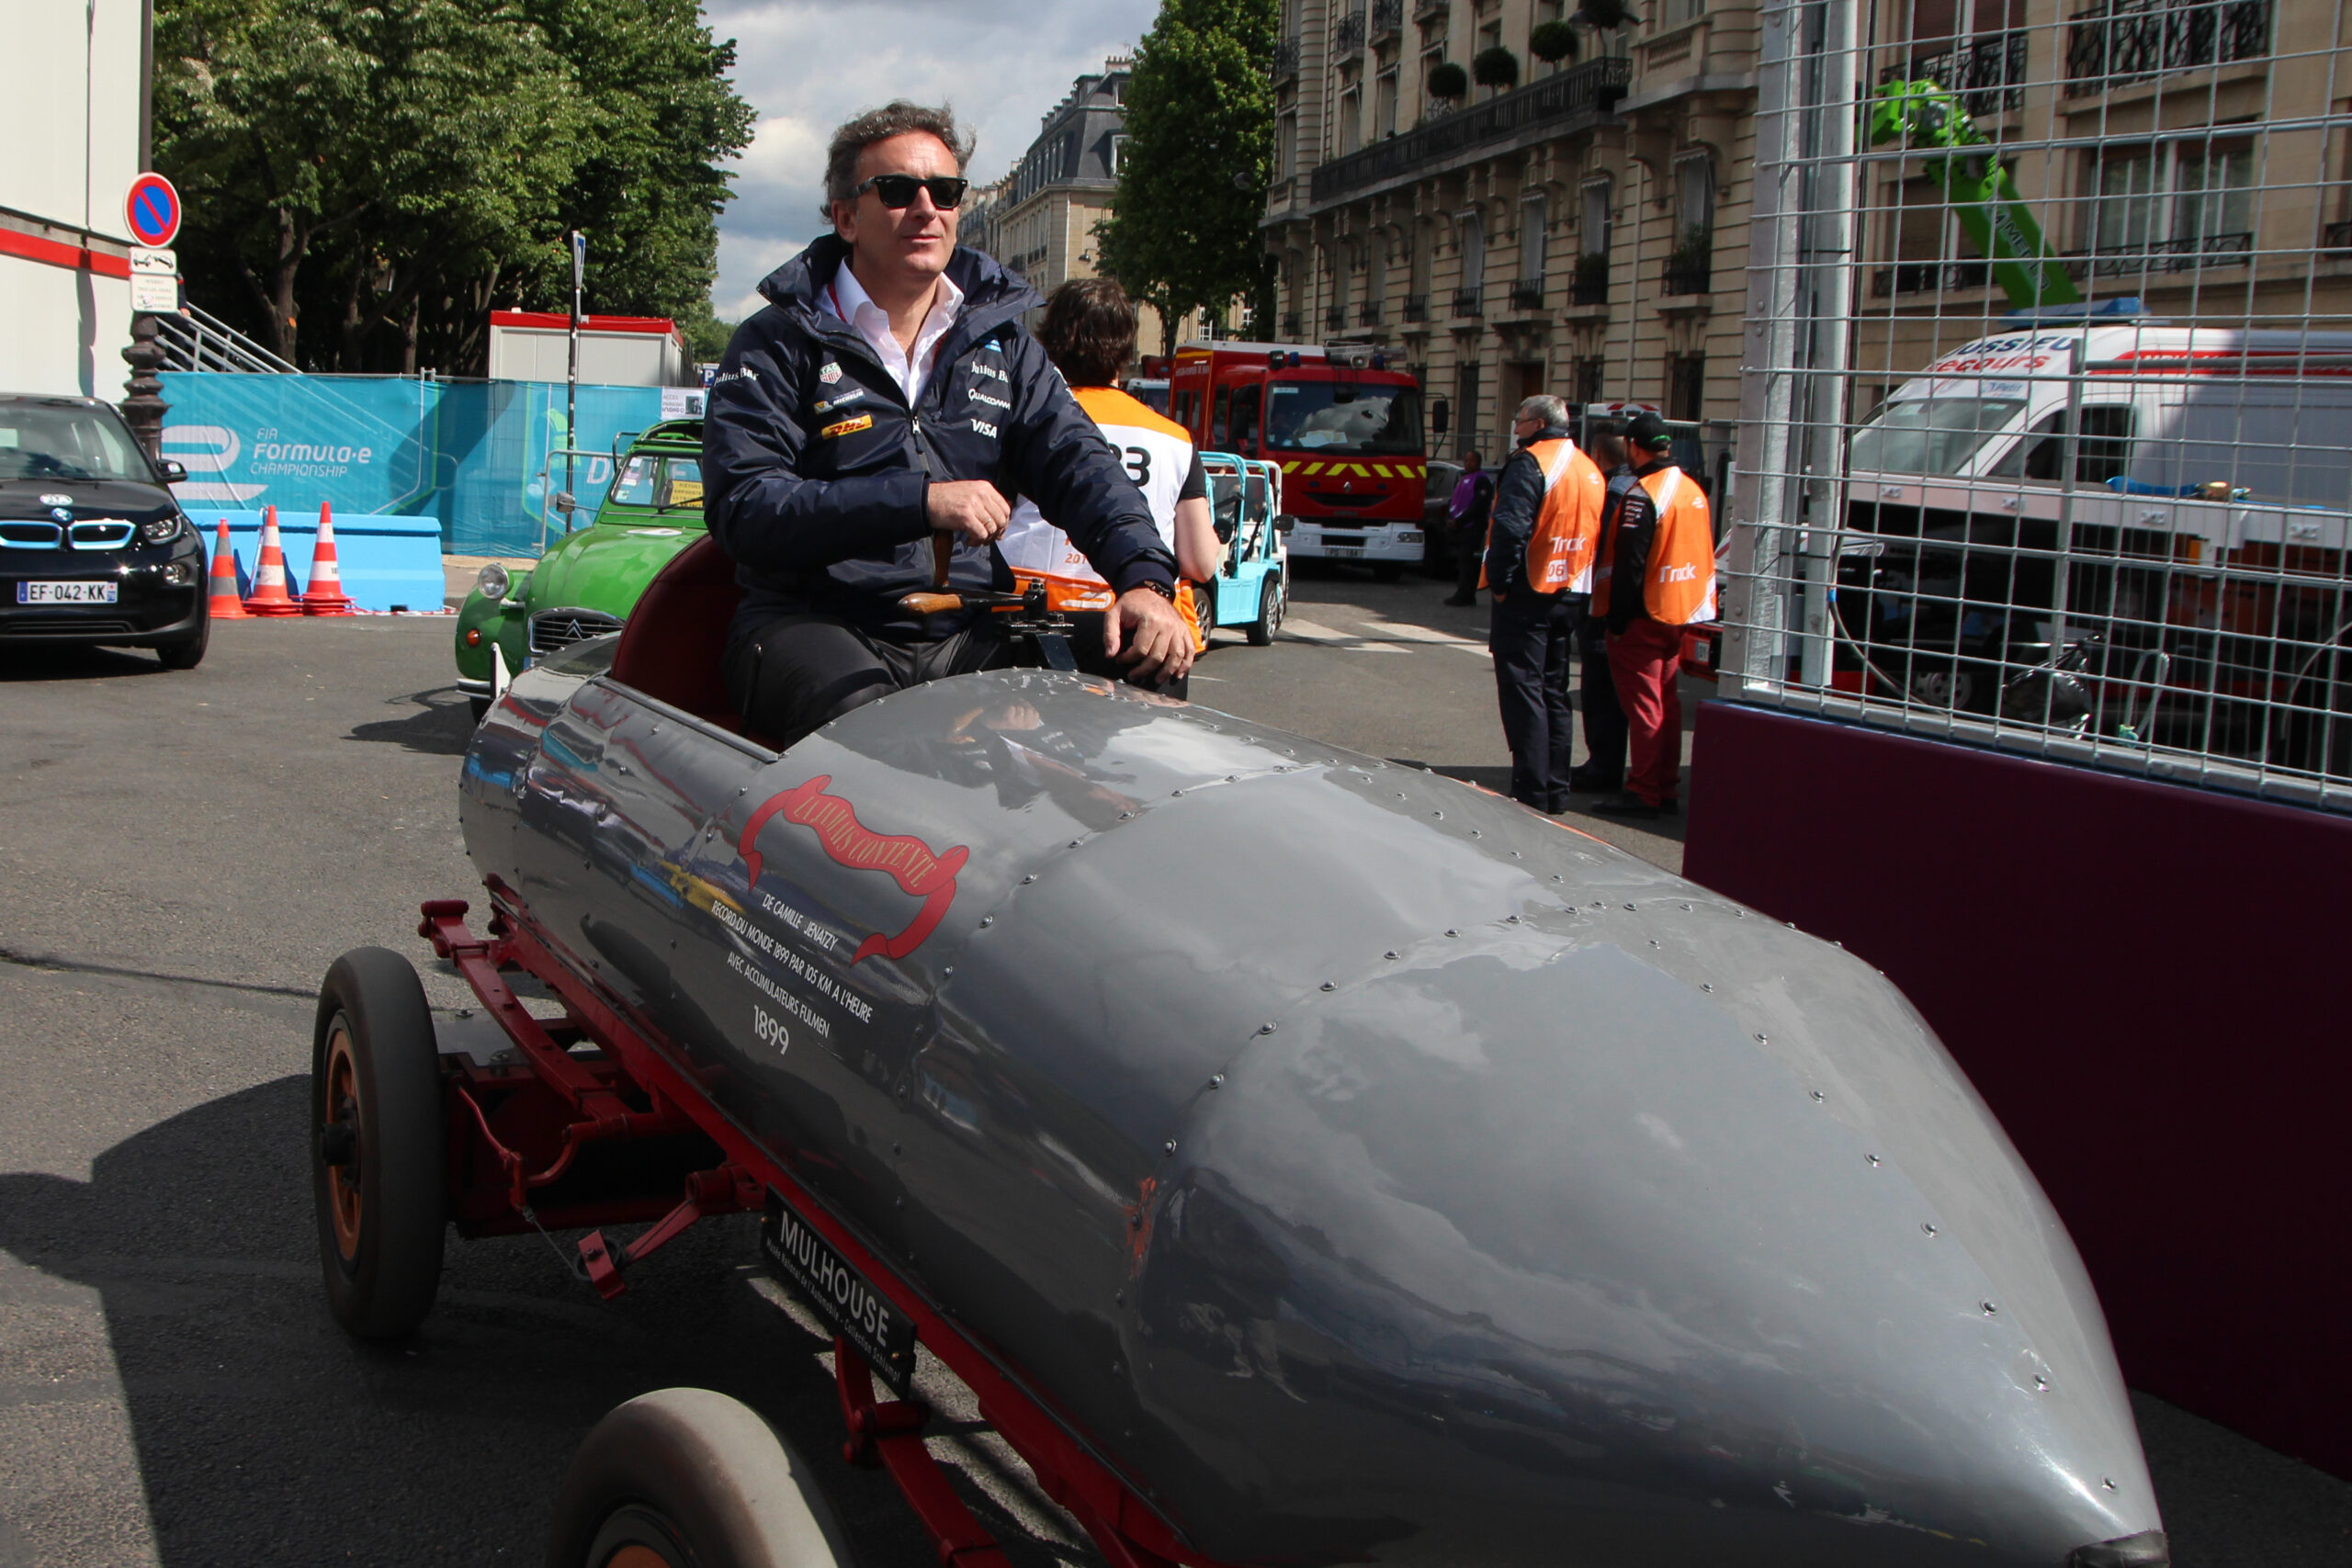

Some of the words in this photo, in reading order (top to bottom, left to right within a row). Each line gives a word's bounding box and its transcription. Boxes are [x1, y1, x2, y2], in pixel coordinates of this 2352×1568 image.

[704, 369, 715, 382] P
[821, 362, 839, 374] TAG
[971, 361, 996, 378] Julius
[833, 389, 864, 405] MICHELIN
[257, 427, 278, 440] FIA
[830, 420, 865, 435] DHL
[970, 418, 998, 439] VISA
[250, 462, 348, 478] CHAMPIONSHIP
[1547, 564, 1564, 577] 06
[1659, 562, 1697, 583] Track
[794, 796, 820, 820] LA
[848, 837, 937, 888] CONTENTE
[763, 894, 775, 910] DE
[773, 900, 804, 929] CAMILLE
[804, 920, 839, 951] JENATZY
[711, 900, 737, 927] RECORD
[735, 917, 748, 935] DU
[746, 925, 774, 953] MONDE
[773, 942, 789, 964] 1899
[788, 953, 805, 976] PAR
[804, 964, 819, 985] 105
[817, 973, 832, 995] KM
[831, 985, 840, 1001] A
[840, 988, 873, 1023] L'HEURE
[727, 951, 744, 974] AVEC
[744, 964, 799, 1015] ACCUMULATEURS
[799, 1004, 830, 1038] FULMEN
[754, 1004, 789, 1055] 1899
[781, 1211, 889, 1348] MULHOUSE
